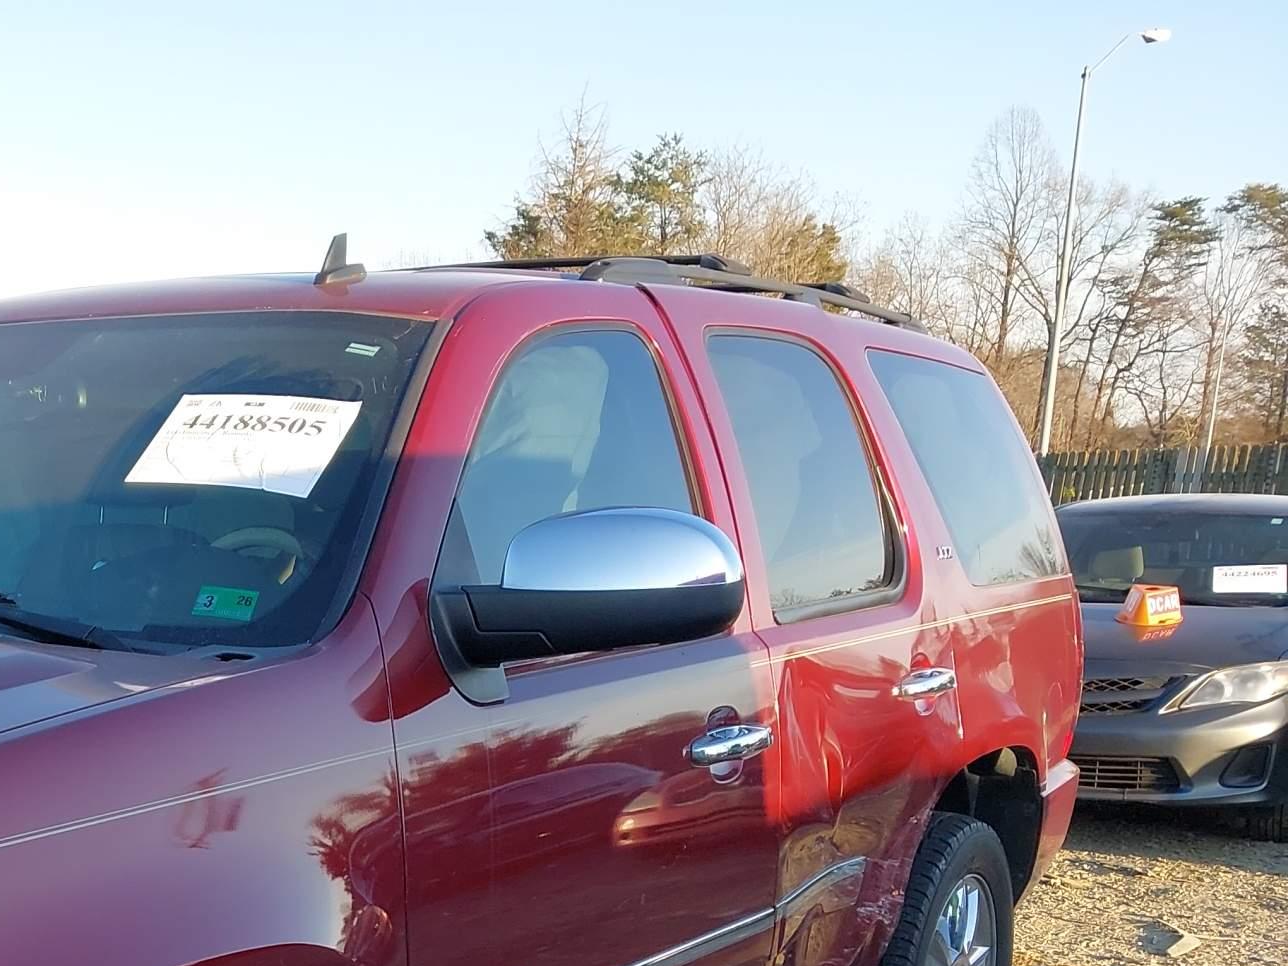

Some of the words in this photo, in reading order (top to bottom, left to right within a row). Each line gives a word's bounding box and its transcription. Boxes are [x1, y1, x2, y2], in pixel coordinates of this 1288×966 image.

[182, 413, 328, 437] 44188505
[203, 595, 215, 609] 3
[236, 595, 253, 607] 26
